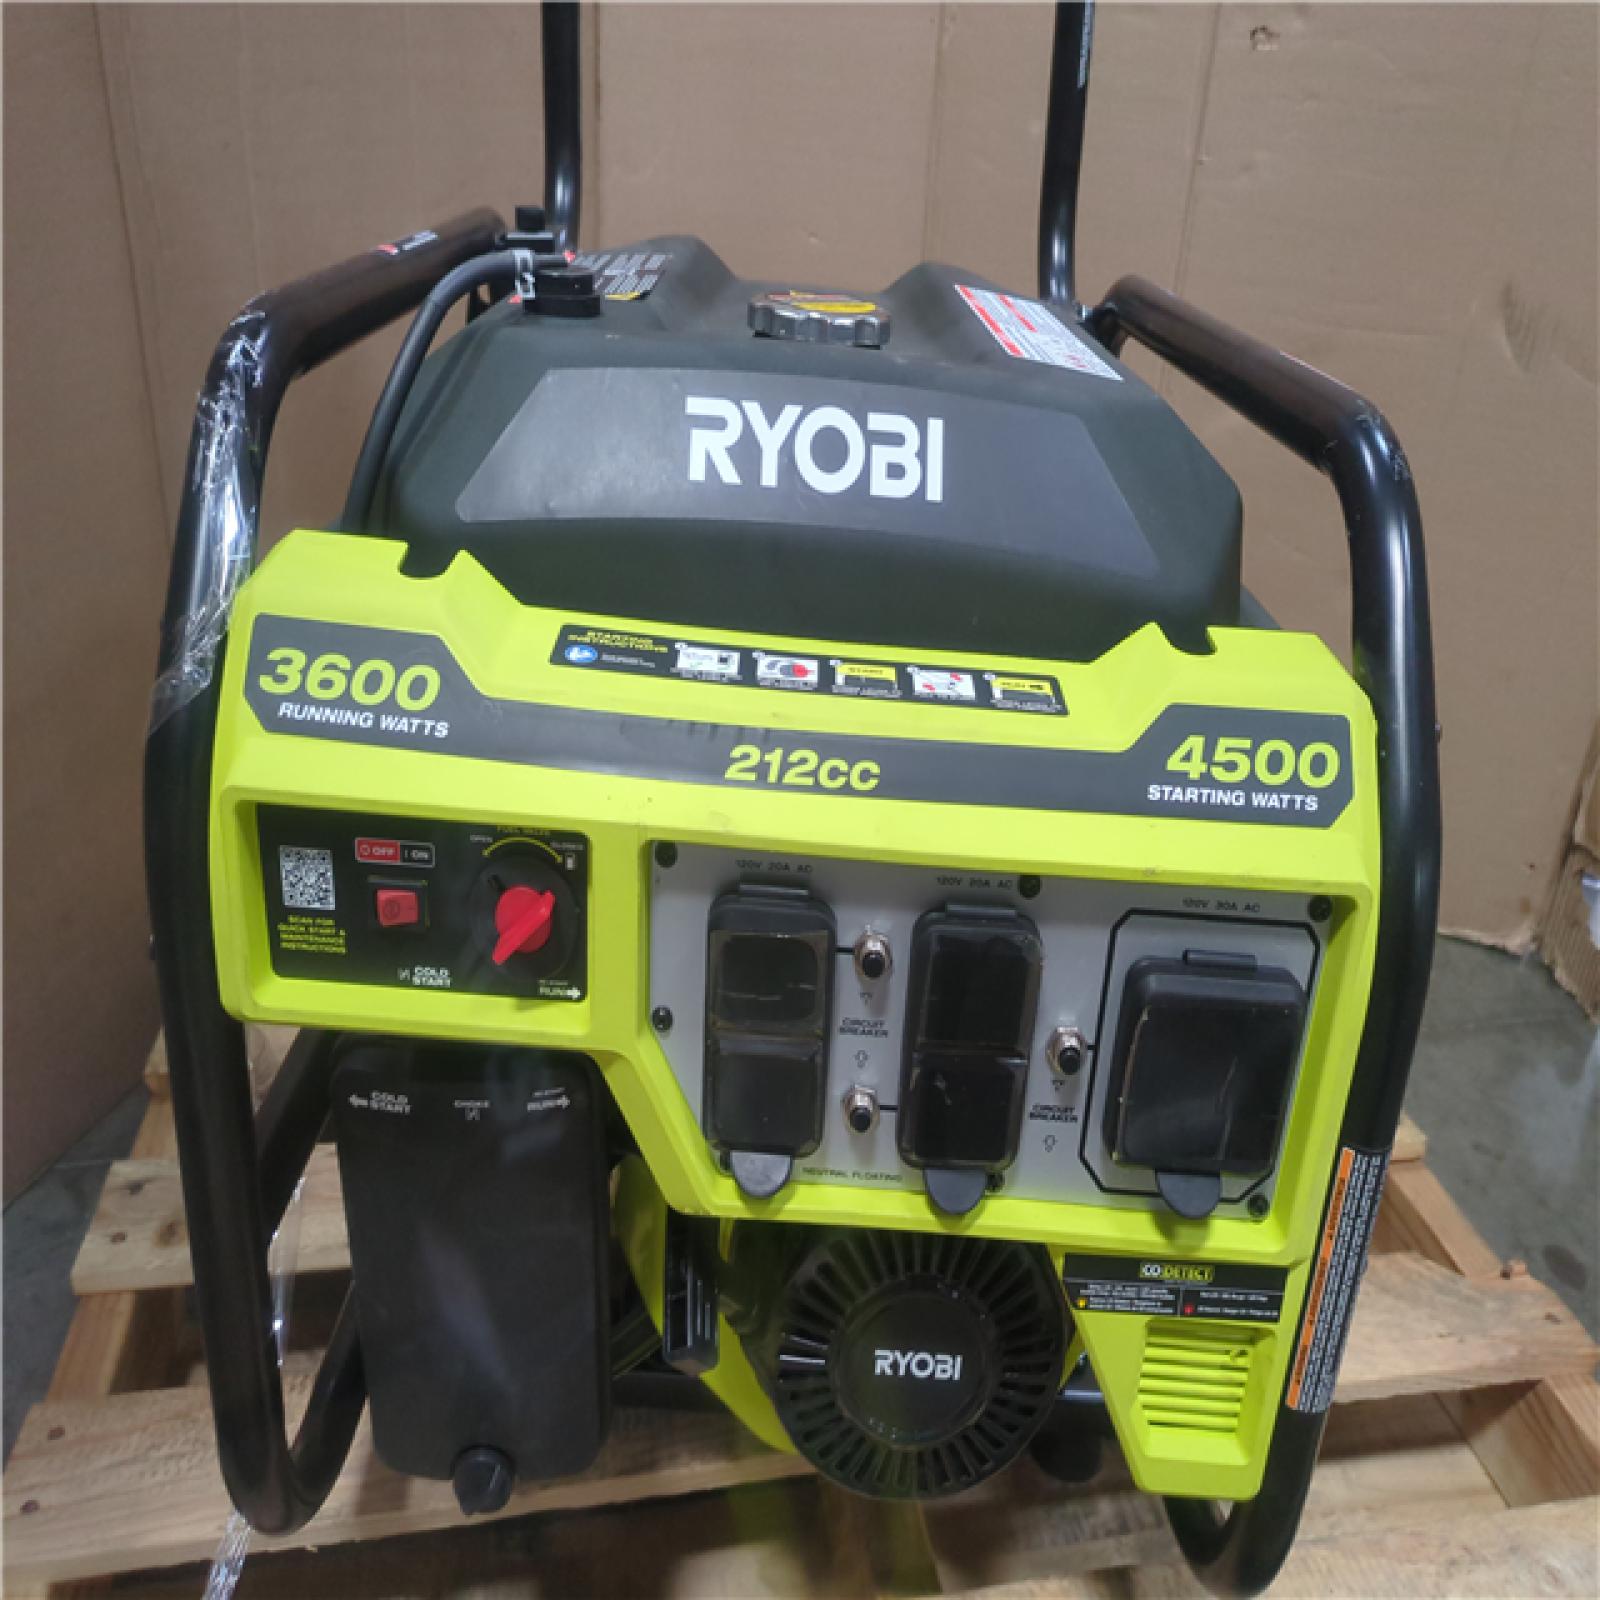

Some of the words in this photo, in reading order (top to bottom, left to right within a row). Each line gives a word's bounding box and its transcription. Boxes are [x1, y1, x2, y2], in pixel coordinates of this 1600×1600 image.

[685, 395, 944, 502] RYOBI
[259, 646, 441, 712] 3600
[278, 702, 374, 728] RUNNING
[380, 714, 449, 738] WATTS
[1165, 734, 1340, 788] 4500
[1147, 784, 1245, 806] STARTING
[1252, 791, 1318, 811] WATTS
[874, 1349, 963, 1380] RYOBI
